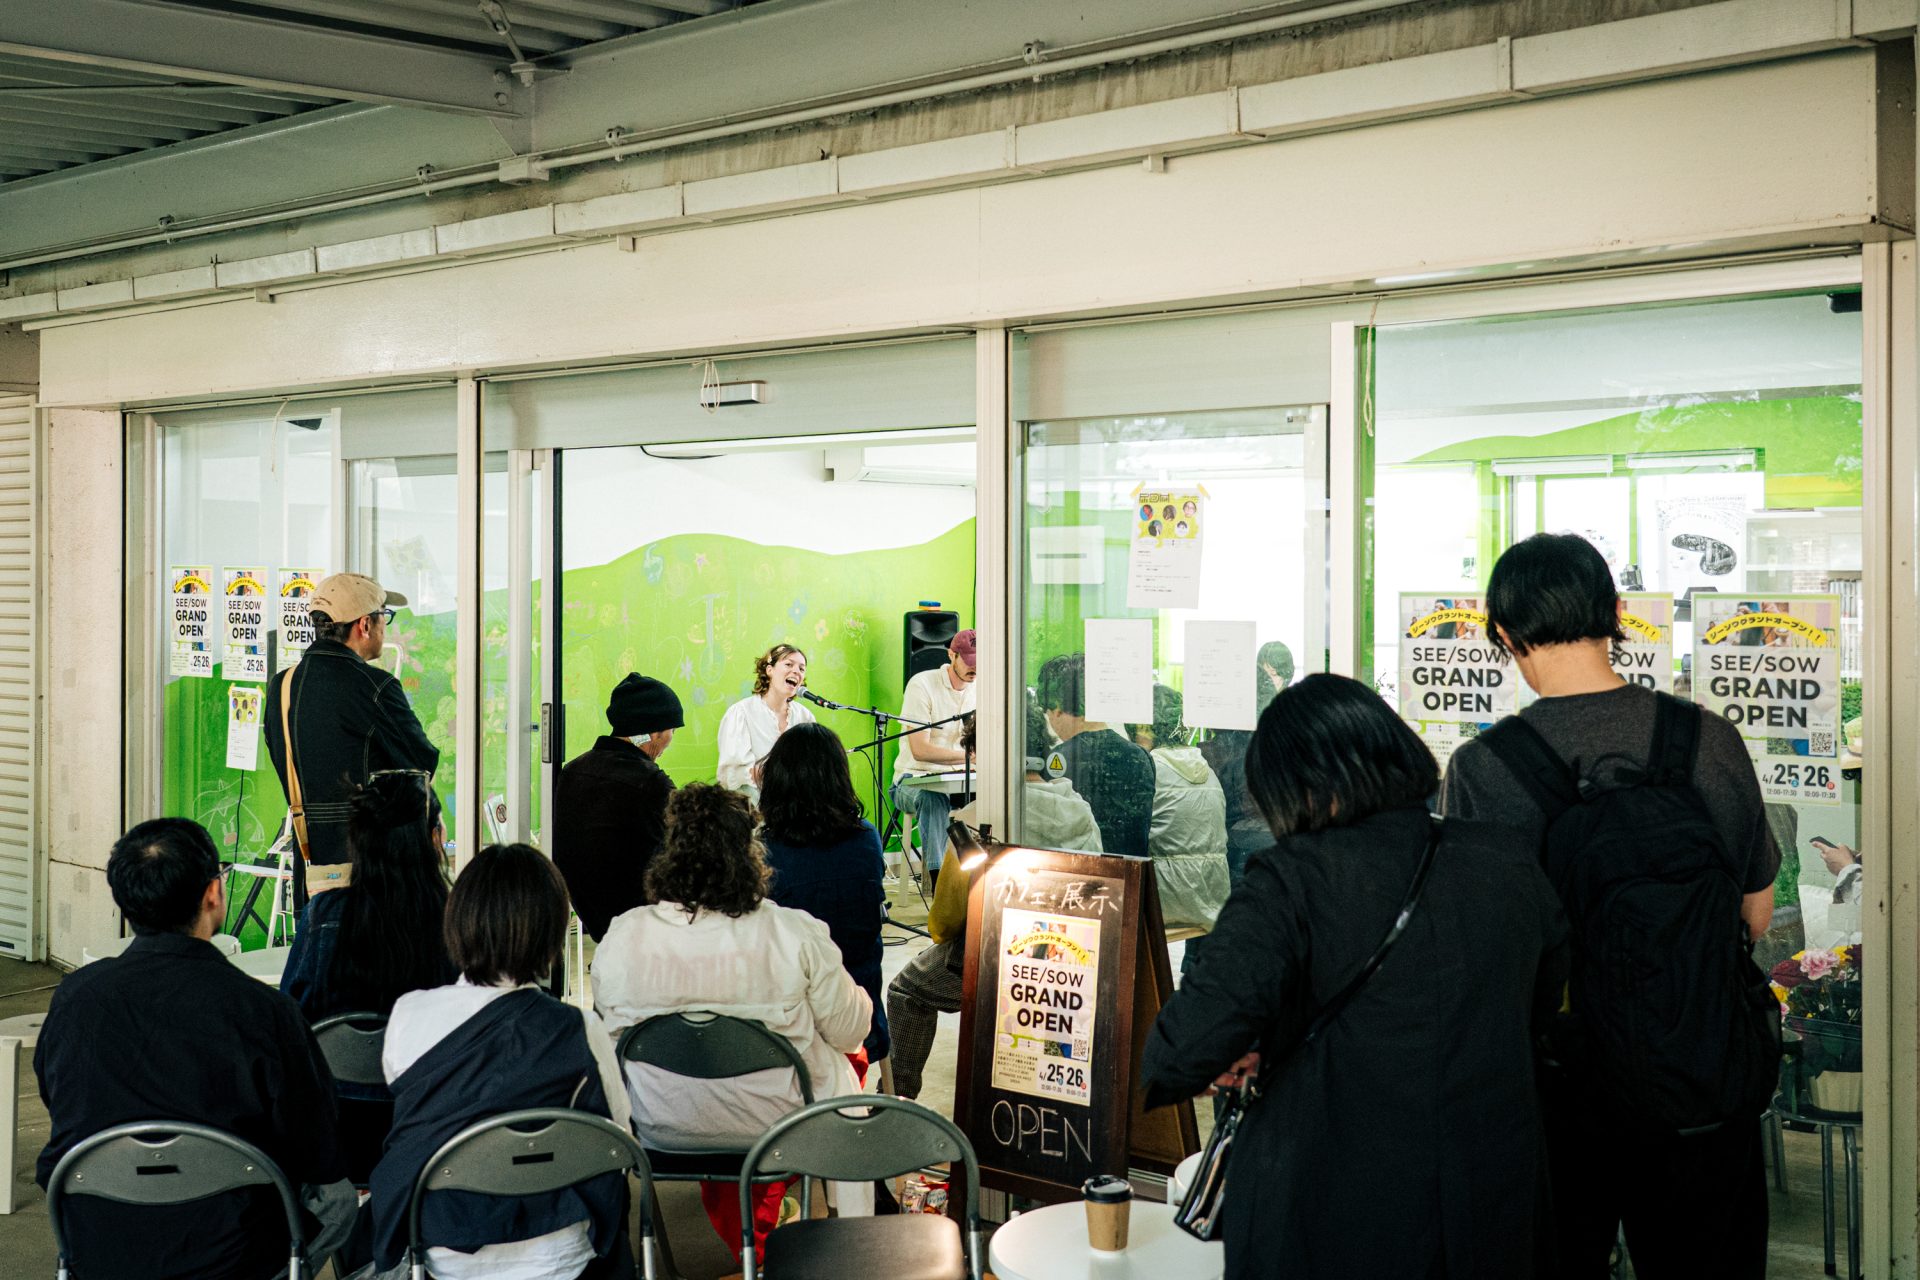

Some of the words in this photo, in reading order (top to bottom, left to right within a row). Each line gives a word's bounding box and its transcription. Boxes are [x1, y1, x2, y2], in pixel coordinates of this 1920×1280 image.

[175, 598, 207, 608] SEE/SOW
[228, 600, 261, 610] SEE/SOW
[283, 602, 310, 613] SEE/SO
[175, 610, 207, 622] GRAND
[228, 612, 261, 625] GRAND
[283, 614, 315, 627] GRAN
[179, 624, 204, 636] OPEN
[232, 627, 257, 640] OPEN
[287, 630, 314, 643] OPEN
[1412, 646, 1502, 665] SEE/SOW
[1710, 654, 1821, 674] SEE/SOW
[1412, 667, 1503, 688] GRAND
[1710, 676, 1821, 700] GRAND
[1423, 692, 1493, 713] OPEN
[1723, 703, 1808, 728] OPEN
[1804, 765, 1830, 788] 26
[1011, 964, 1084, 988] SEE/SOW
[1010, 983, 1083, 1011] GRAND
[1016, 1008, 1073, 1035] OPEN
[1066, 1066, 1083, 1087] 26
[991, 1100, 1092, 1163] OPEN
